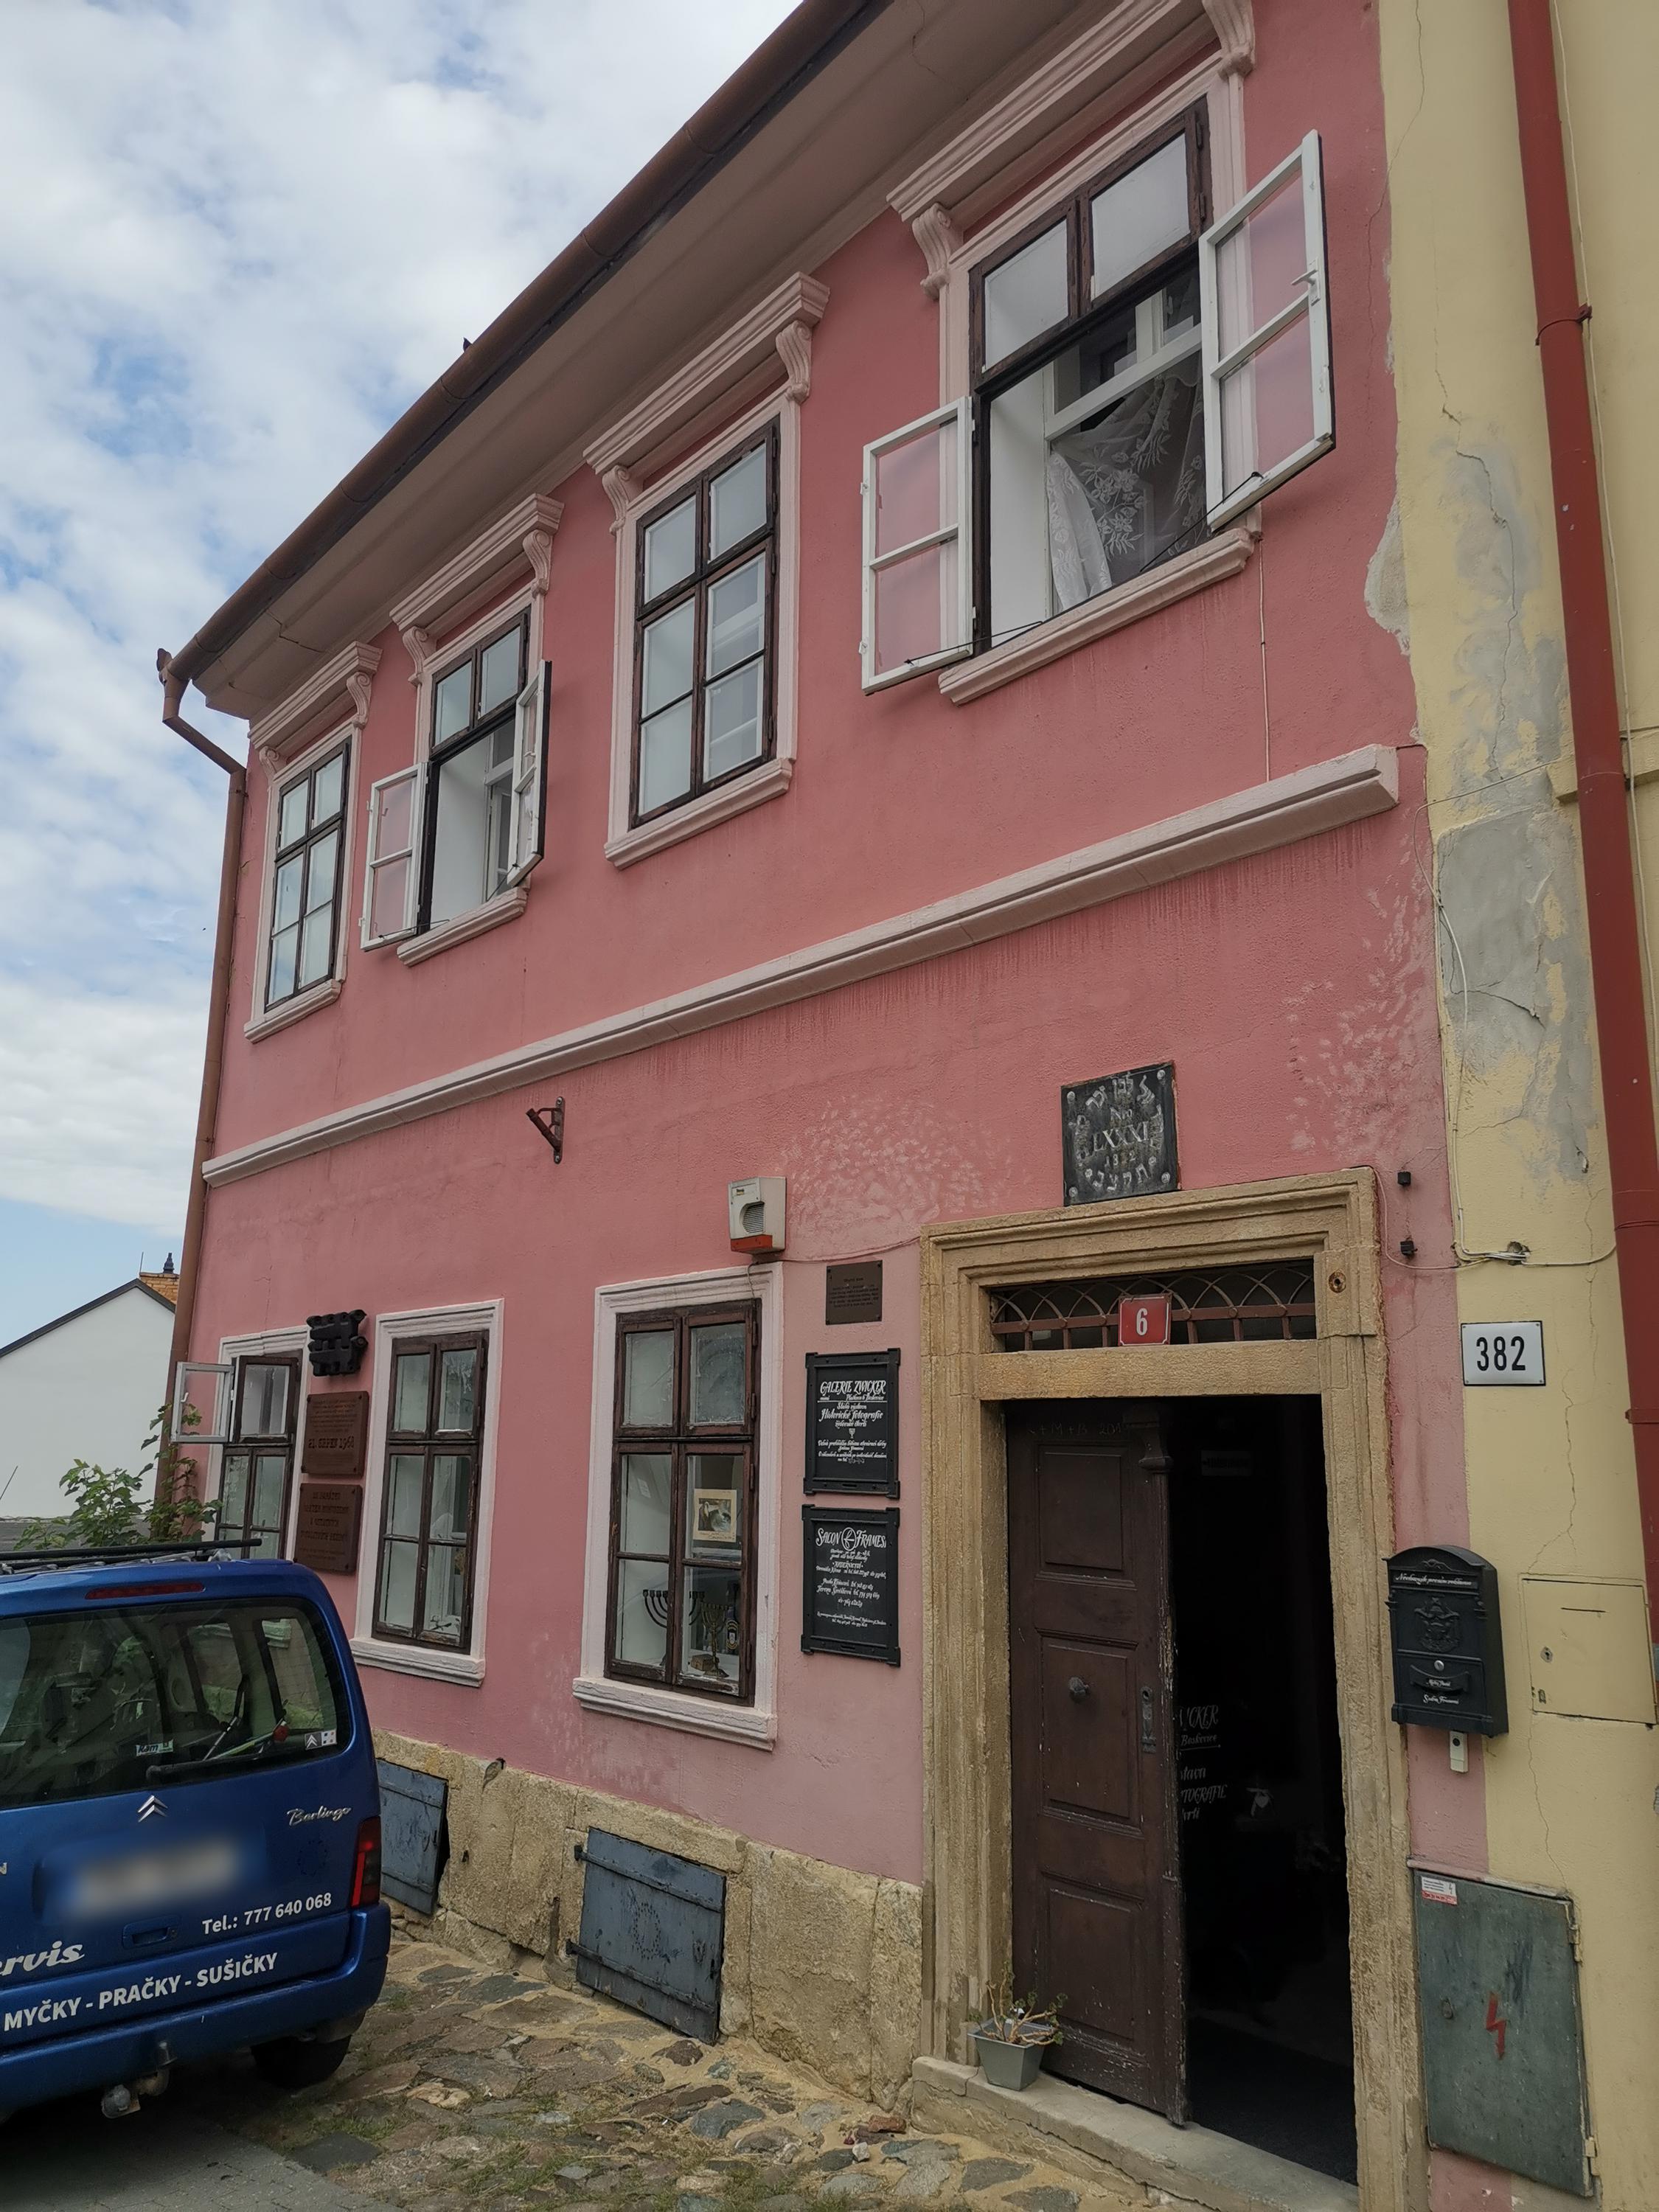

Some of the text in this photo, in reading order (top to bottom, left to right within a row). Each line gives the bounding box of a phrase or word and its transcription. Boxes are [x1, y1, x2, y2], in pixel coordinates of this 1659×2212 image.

[1136, 1307, 1148, 1336] 6
[1476, 1336, 1526, 1371] 382
[820, 1380, 886, 1396] GALERIE ZWICKER
[818, 1408, 884, 1422] Historické fotografie
[287, 1805, 352, 1826] Berlingo
[202, 1893, 332, 1935] Tel.: 777 640 068
[4, 1997, 82, 2032] MYČKY
[99, 1975, 182, 2011] PRAČKY
[197, 1952, 278, 1988] SUŠIČKY
